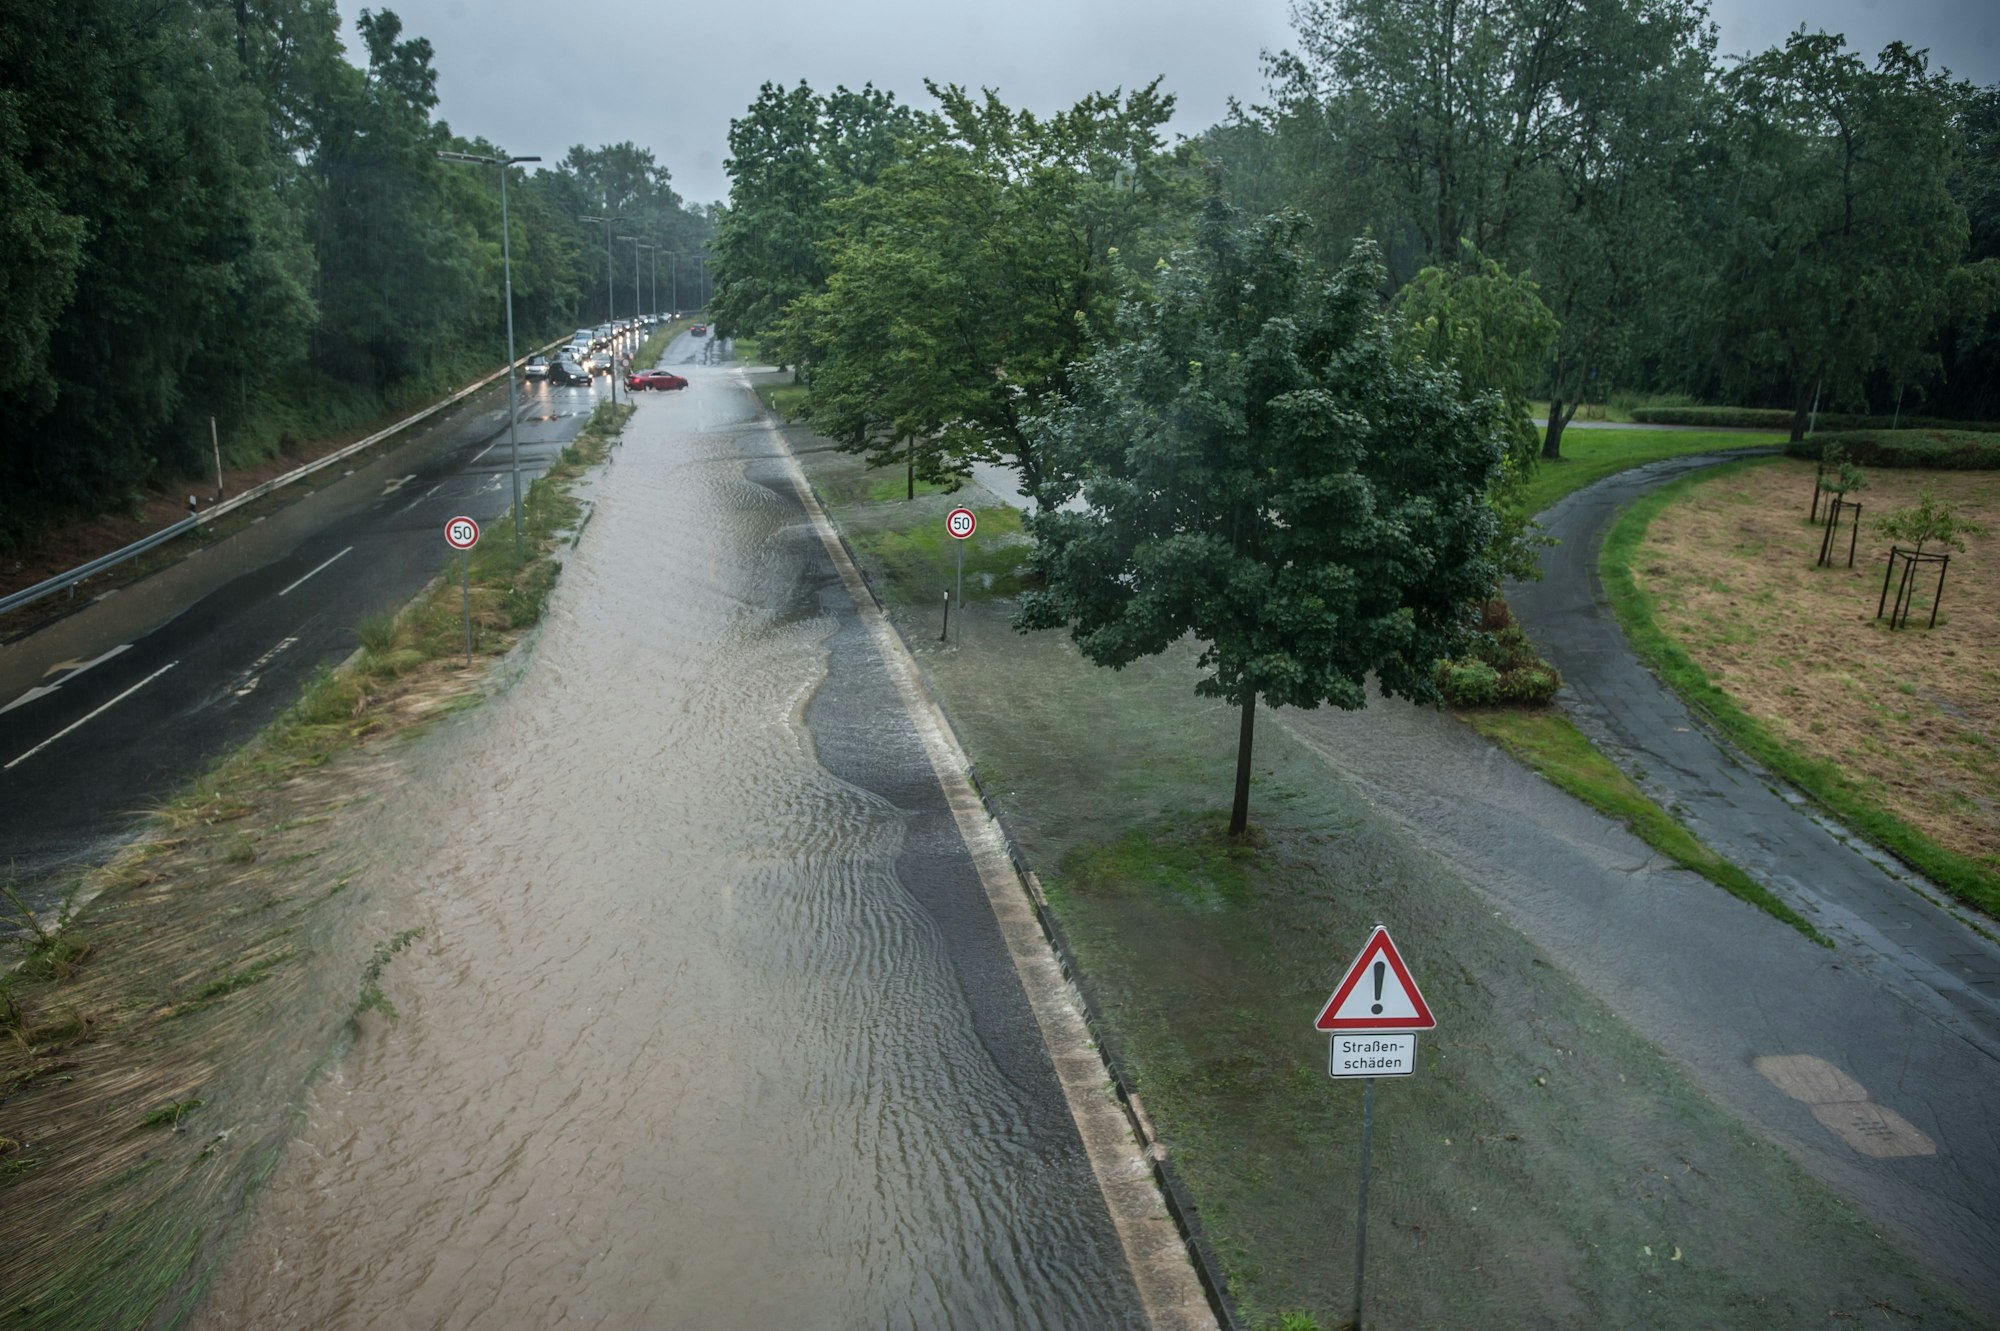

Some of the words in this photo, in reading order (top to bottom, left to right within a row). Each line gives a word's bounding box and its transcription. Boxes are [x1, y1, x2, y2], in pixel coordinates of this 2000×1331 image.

[954, 517, 970, 530] 50
[453, 526, 472, 540] 50
[1342, 1040, 1405, 1053] Straßen-
[1344, 1057, 1402, 1069] schäden
